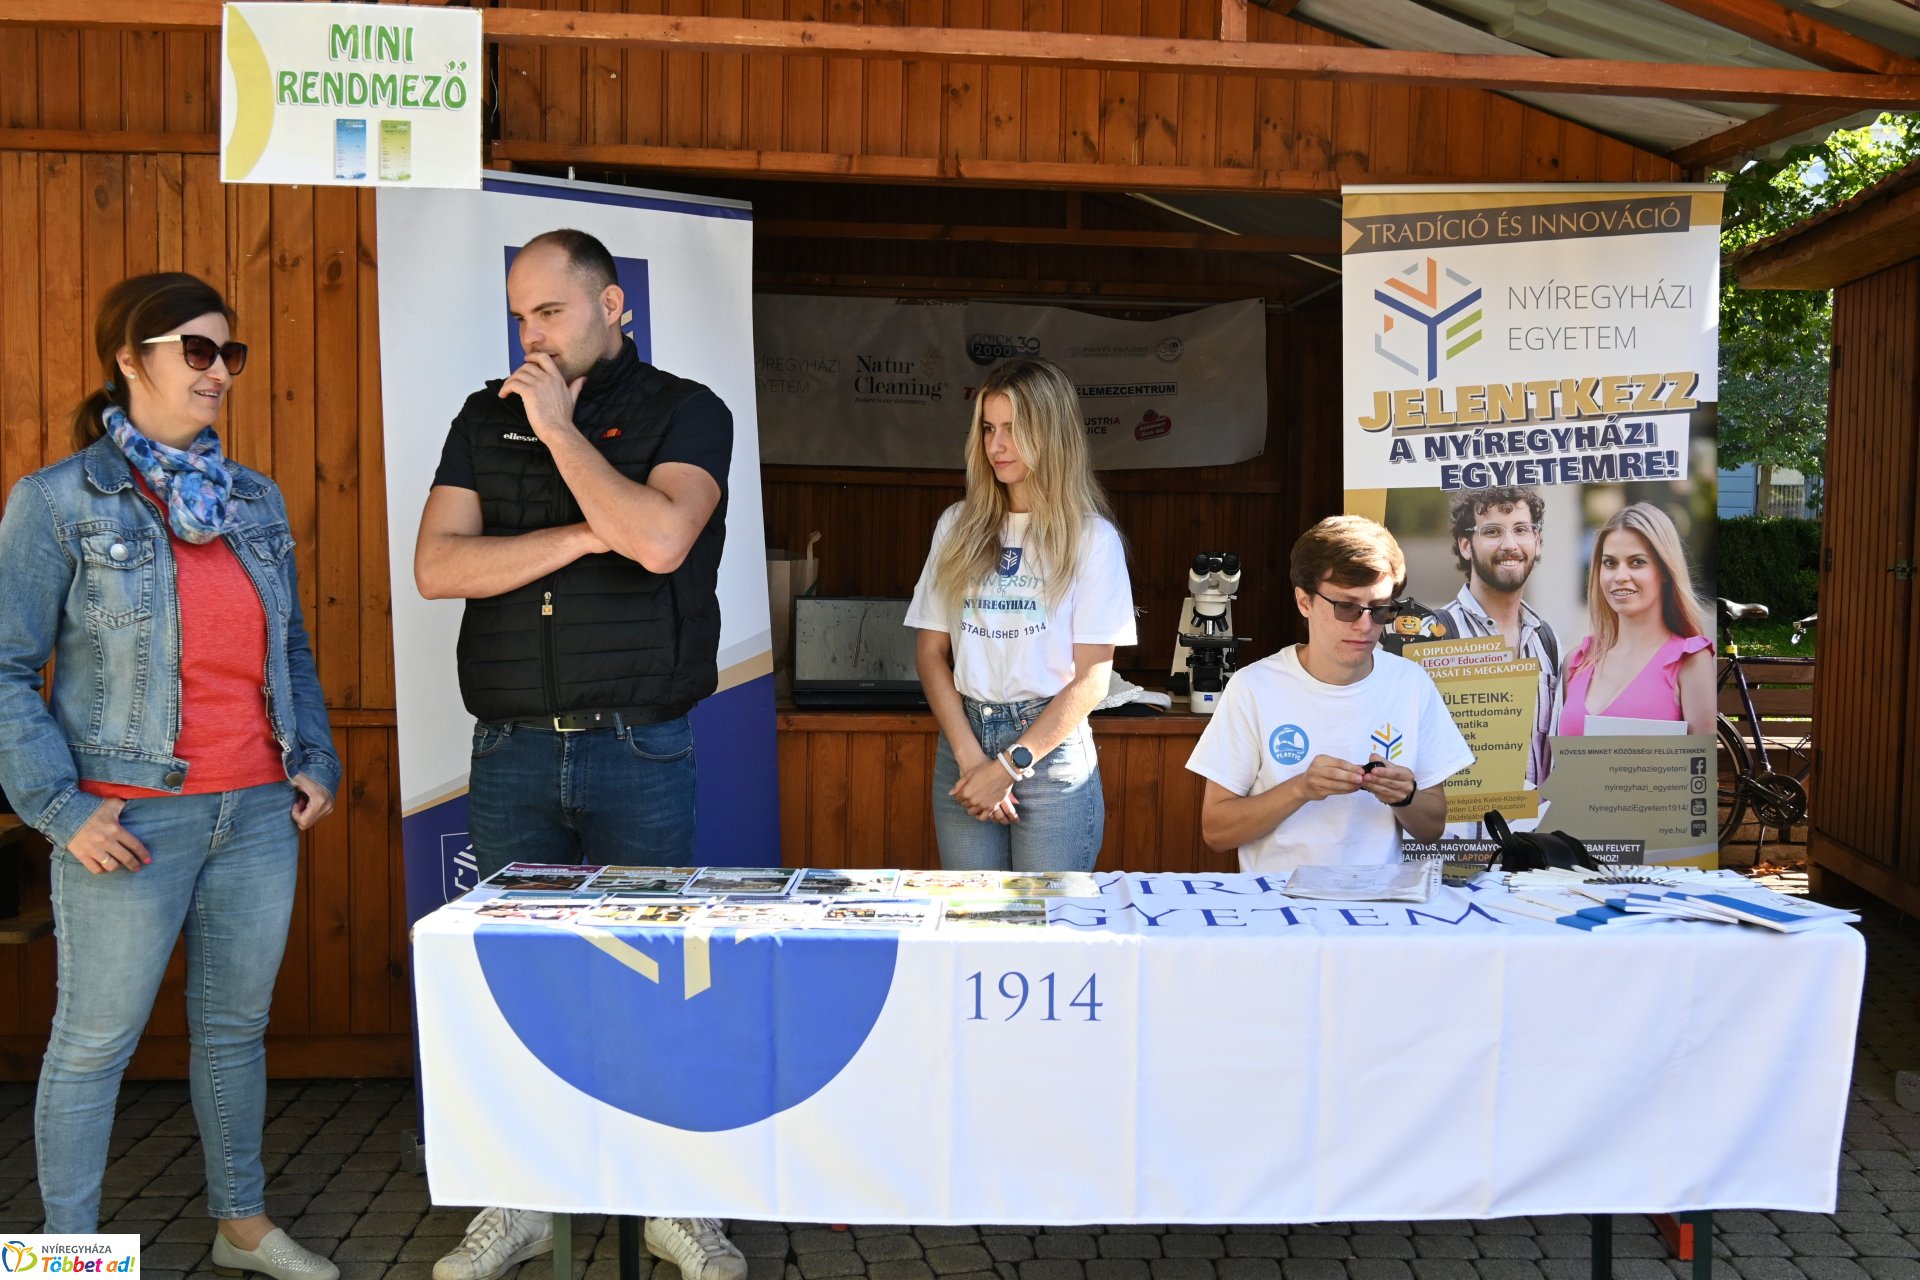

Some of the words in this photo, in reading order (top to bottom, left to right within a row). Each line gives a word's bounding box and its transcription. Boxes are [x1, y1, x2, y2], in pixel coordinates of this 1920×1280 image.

[330, 23, 414, 62] MINI
[278, 60, 468, 109] RENDMEZŐ
[1366, 212, 1489, 245] TRADÍCIÓ
[1498, 210, 1522, 237] ÉS
[1531, 202, 1681, 236] INNOVÁCIÓ
[1508, 279, 1692, 310] NYÍREGYHÁZI
[1508, 326, 1637, 351] EGYETEM
[975, 345, 1012, 356] 2000
[856, 355, 914, 374] Natur
[855, 376, 942, 401] Cleaning
[1358, 371, 1700, 433] JELENTKEZZ
[1084, 417, 1121, 426] USTRIA
[503, 432, 538, 442] ellesse
[1389, 438, 1415, 463] A
[1441, 450, 1680, 490] EGYETEMRE!
[960, 621, 1019, 639] STABLISHED
[1024, 622, 1047, 636] 1914
[1413, 649, 1420, 657] A
[1423, 642, 1501, 657] DIPLOMÁDHOZ
[1429, 667, 1461, 679] DÁSÁT
[1463, 668, 1471, 676] IS
[1474, 663, 1536, 675] MEGKAPOD!
[1443, 691, 1514, 705] ÜLETEINK:
[1450, 707, 1522, 718] porttudomány
[1456, 720, 1489, 729] matika
[1470, 741, 1523, 752] tudomány
[1275, 752, 1302, 761] PLASTIC
[1443, 778, 1483, 788] domány
[1659, 827, 1687, 835] nye.hu/
[1441, 841, 1502, 852] HAGYOMÁNYO
[1583, 844, 1604, 852] BAN
[1606, 844, 1641, 852] FELVETT
[1049, 901, 1513, 928] GYETEM
[966, 971, 1103, 1021] 1914
